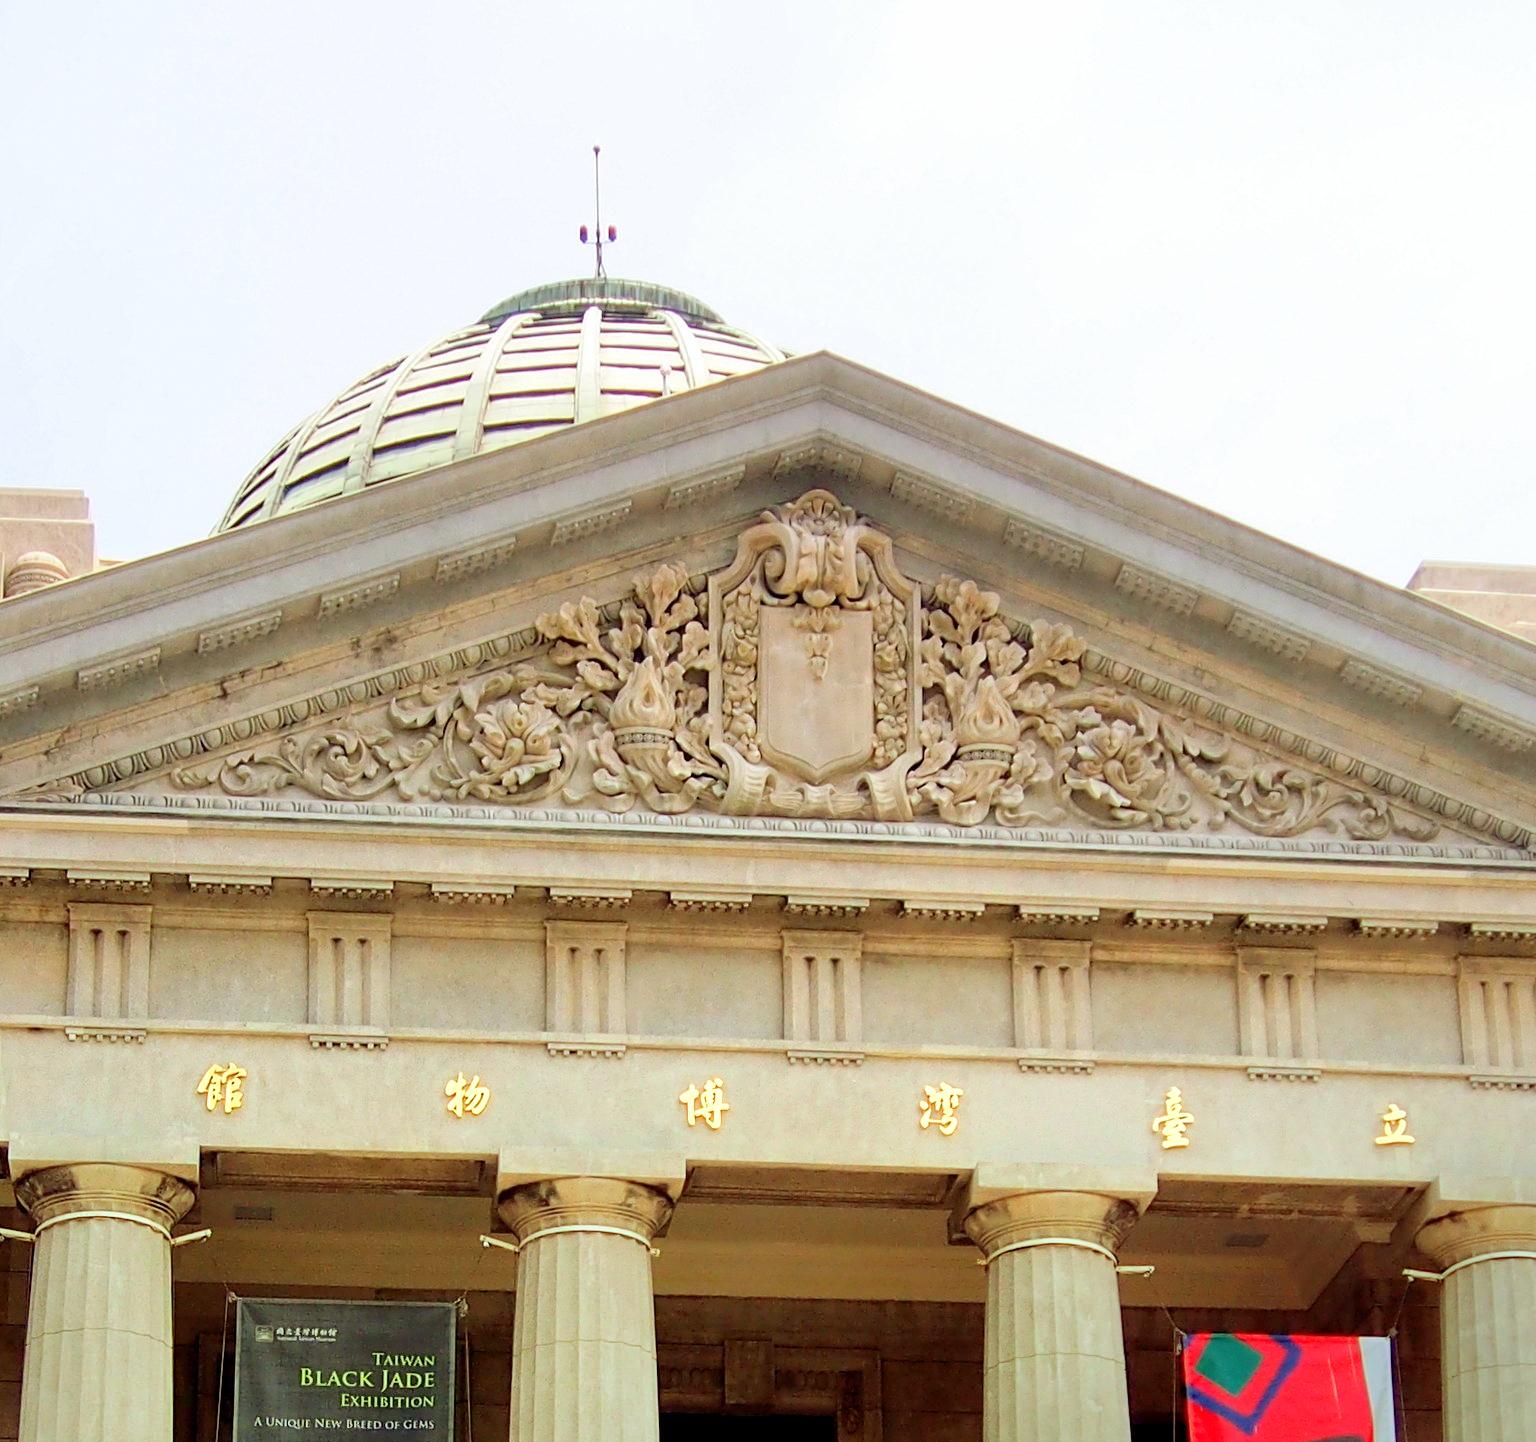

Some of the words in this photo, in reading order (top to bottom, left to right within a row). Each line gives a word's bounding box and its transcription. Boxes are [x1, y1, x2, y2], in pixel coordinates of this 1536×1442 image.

[371, 1352, 436, 1367] TAIWAN
[299, 1367, 376, 1388] BLACK
[380, 1369, 436, 1393] JADE
[340, 1393, 435, 1409] EXHIBITION
[254, 1416, 263, 1428] A
[265, 1416, 312, 1429] UNIQUE
[314, 1417, 342, 1429] NEW
[346, 1419, 382, 1430] BREED
[385, 1420, 401, 1430] OF
[403, 1419, 435, 1430] GEMS
